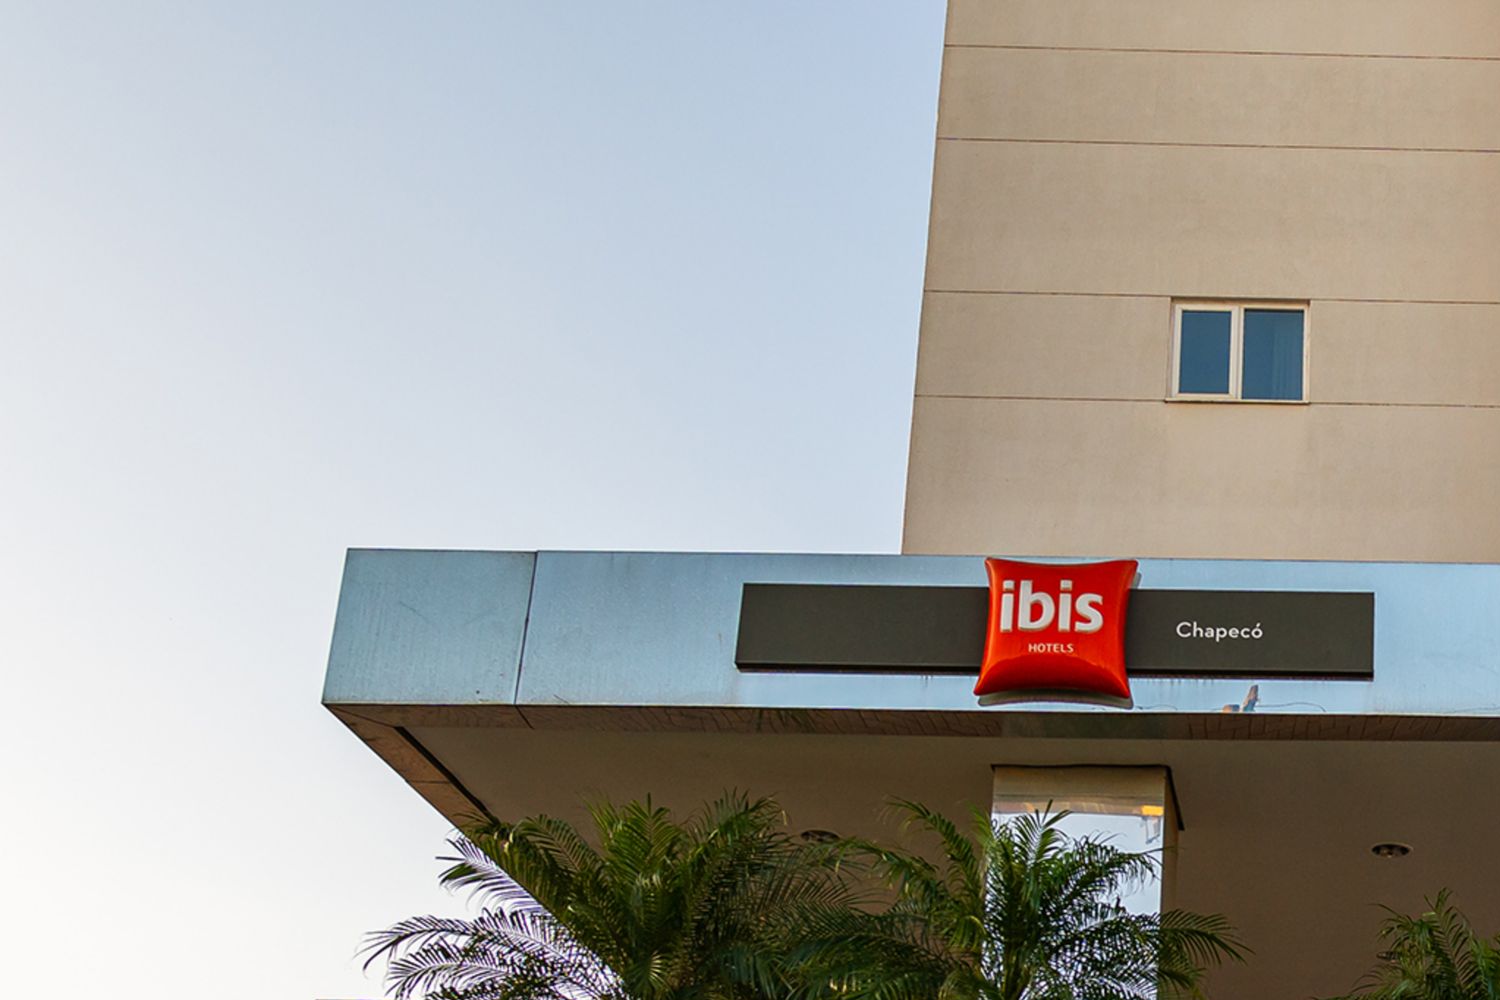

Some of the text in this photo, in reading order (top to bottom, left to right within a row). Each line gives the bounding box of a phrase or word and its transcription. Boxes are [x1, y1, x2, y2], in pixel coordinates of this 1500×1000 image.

[1000, 579, 1104, 633] ibis
[1176, 621, 1263, 642] Chapecó
[1028, 643, 1074, 653] HOTELS
